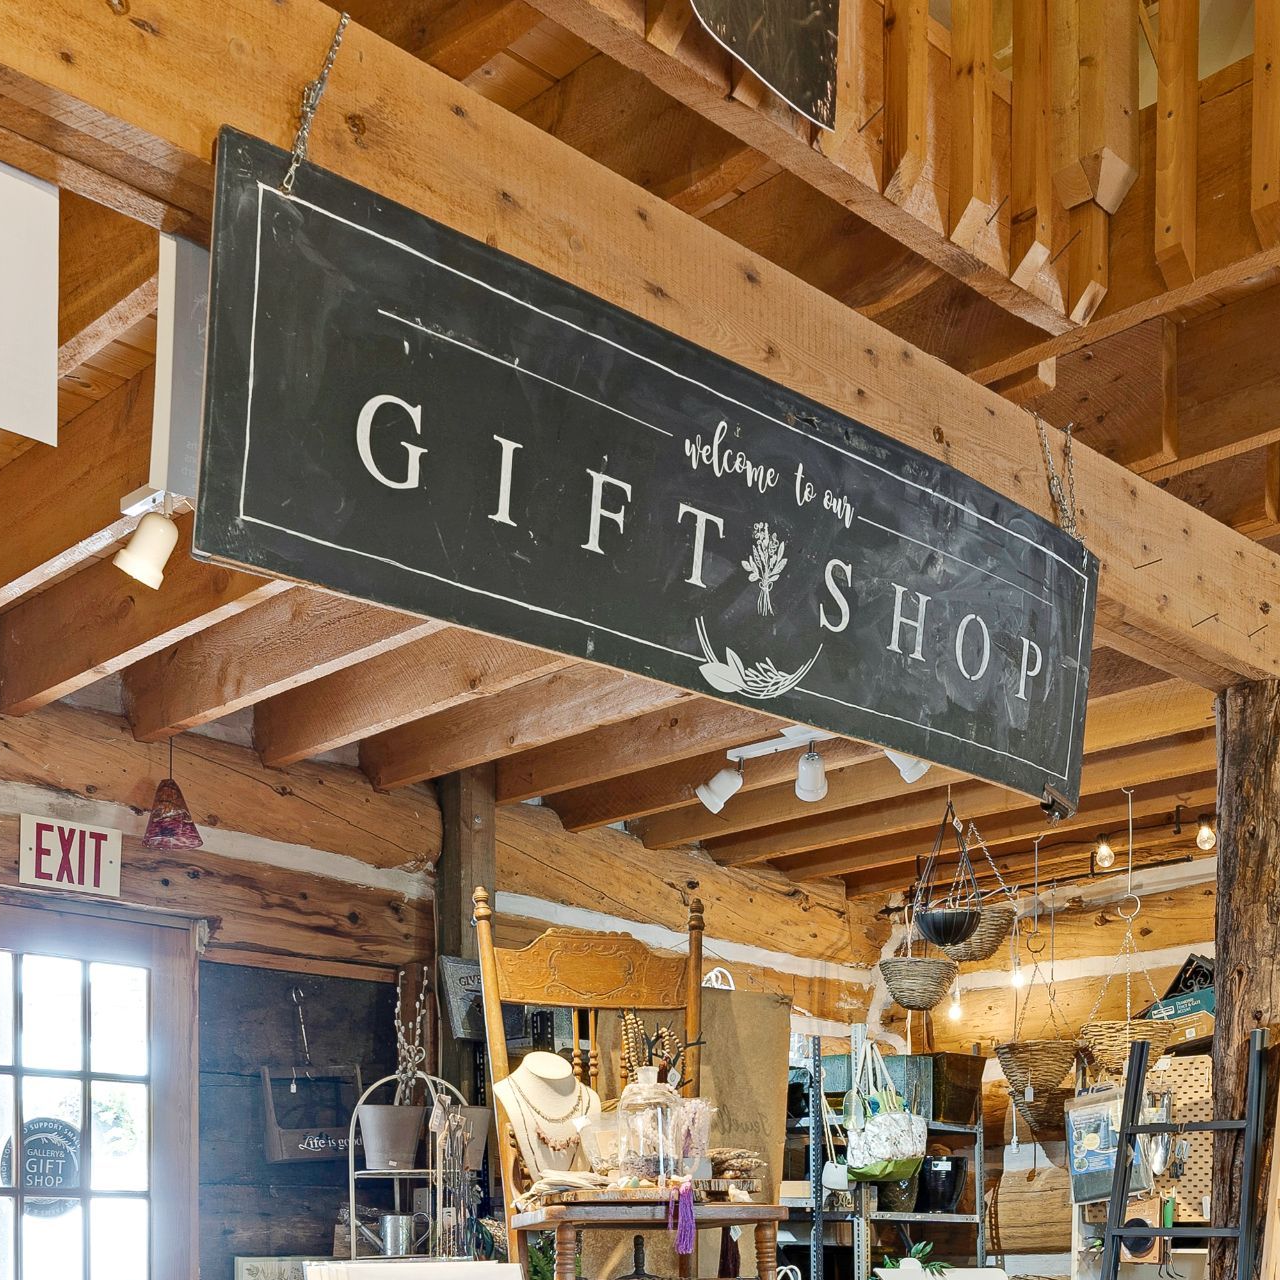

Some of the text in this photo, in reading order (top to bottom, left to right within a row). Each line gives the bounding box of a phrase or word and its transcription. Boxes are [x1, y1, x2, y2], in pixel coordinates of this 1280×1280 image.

[684, 420, 856, 528] welcome to our
[355, 394, 1044, 701] GIFT SHOP
[35, 822, 108, 888] EXIT
[30, 1122, 63, 1131] SUPPORT
[298, 1136, 326, 1151] Life
[328, 1136, 336, 1147] is
[25, 1158, 66, 1174] GIFT
[26, 1175, 63, 1187] SHOP
